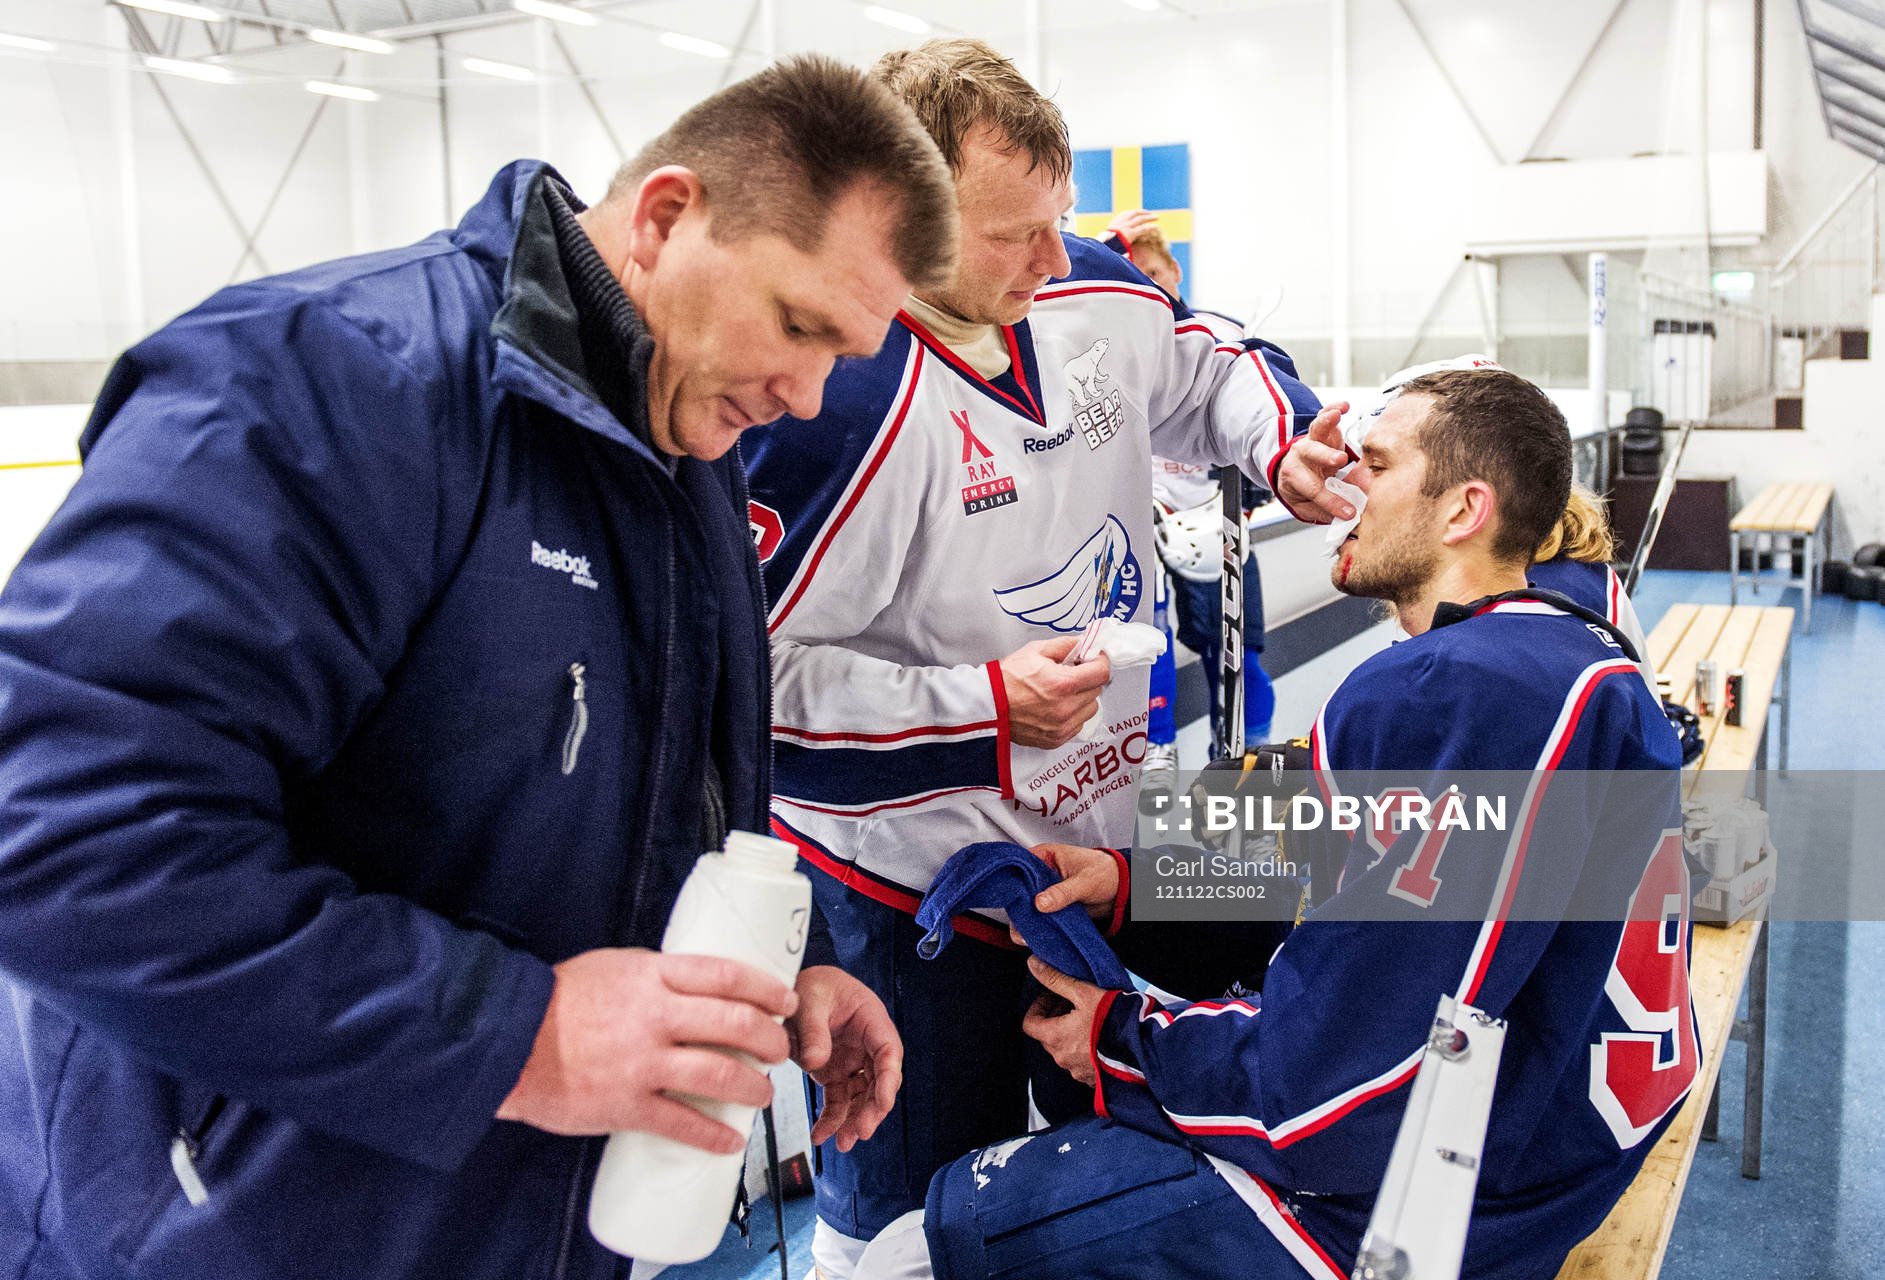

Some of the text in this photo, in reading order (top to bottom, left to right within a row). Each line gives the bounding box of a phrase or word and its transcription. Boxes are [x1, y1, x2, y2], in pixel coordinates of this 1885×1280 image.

[1075, 389, 1122, 434] BEAR
[1023, 424, 1075, 454] Reebok
[1083, 411, 1125, 450] BEER
[967, 460, 997, 482] RAY
[963, 479, 1014, 500] ENERGY
[970, 494, 1011, 512] DRINK
[531, 540, 592, 578] Reebok
[1223, 515, 1242, 673] CCM
[1028, 755, 1076, 791] KONGELIG
